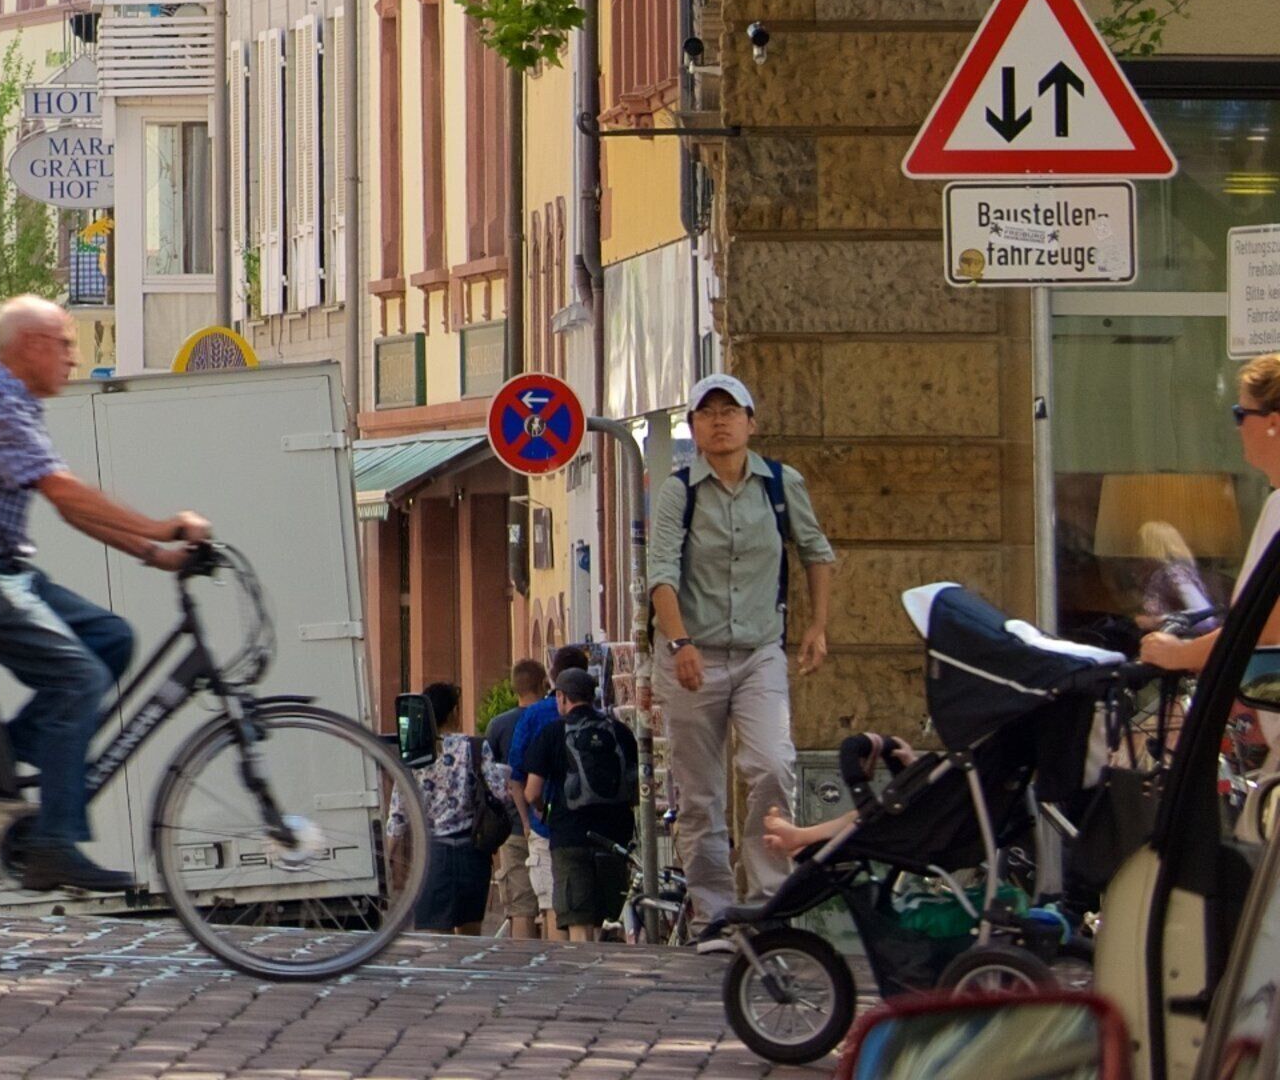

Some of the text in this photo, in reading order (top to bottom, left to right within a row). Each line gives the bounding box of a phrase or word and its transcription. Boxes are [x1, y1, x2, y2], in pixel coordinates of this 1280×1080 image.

[33, 91, 97, 114] HOT
[30, 157, 114, 178] GRÄFL
[49, 180, 99, 199] HOF
[987, 242, 1097, 272] fahrzeuge
